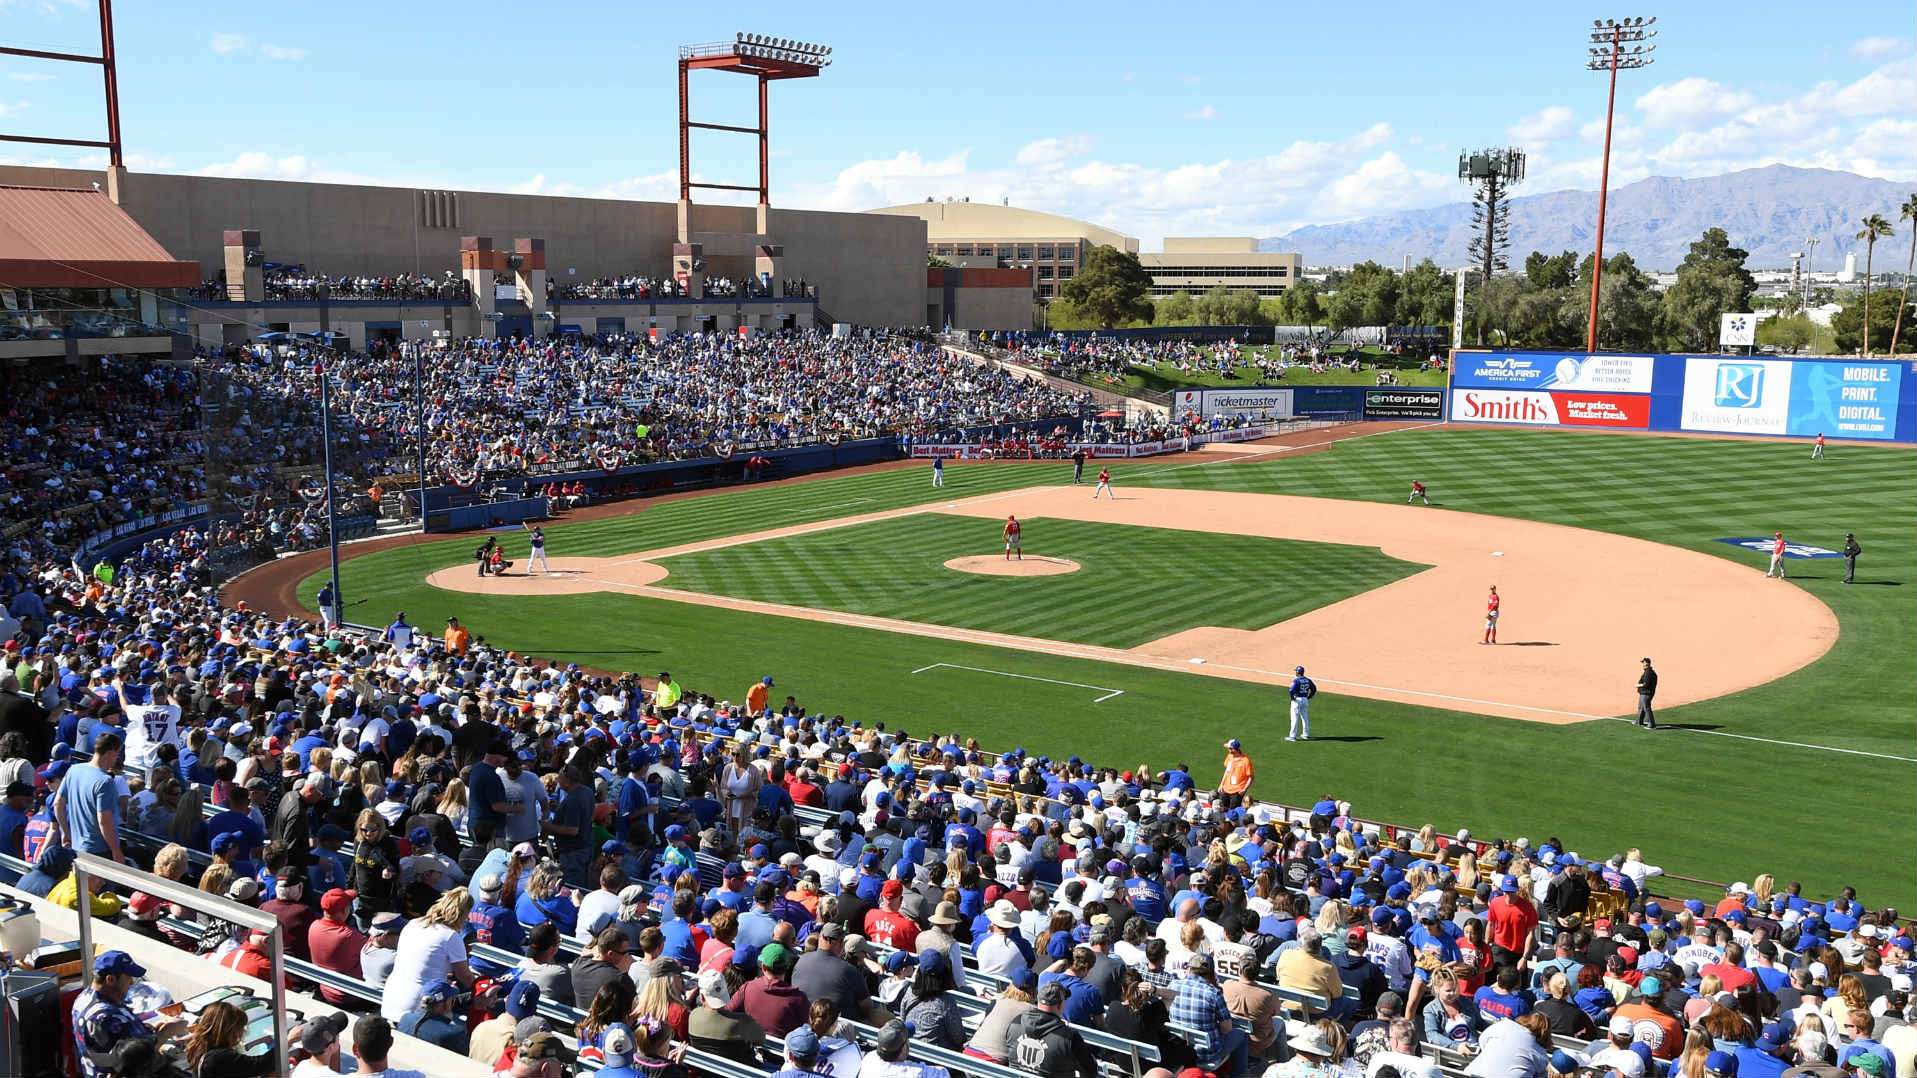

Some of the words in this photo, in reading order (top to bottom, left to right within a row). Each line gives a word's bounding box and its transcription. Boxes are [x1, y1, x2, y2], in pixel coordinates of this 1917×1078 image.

[1474, 368, 1514, 377] AMERICA
[1515, 370, 1541, 378] FIRST
[1843, 367, 1890, 382] MOBILE.
[1371, 394, 1439, 405] enterprise
[1841, 387, 1877, 400] PRINT.
[1214, 396, 1278, 407] ticketmaster
[1464, 392, 1548, 421] Smith's
[1567, 400, 1586, 408] Low
[1587, 401, 1617, 412] prices.
[1568, 409, 1602, 418] Market
[1603, 410, 1628, 420] fresh.
[1839, 406, 1885, 420] DIGITAL.
[145, 723, 168, 742] 17
[1217, 960, 1240, 976] 55
[1480, 998, 1512, 1018] CUBS
